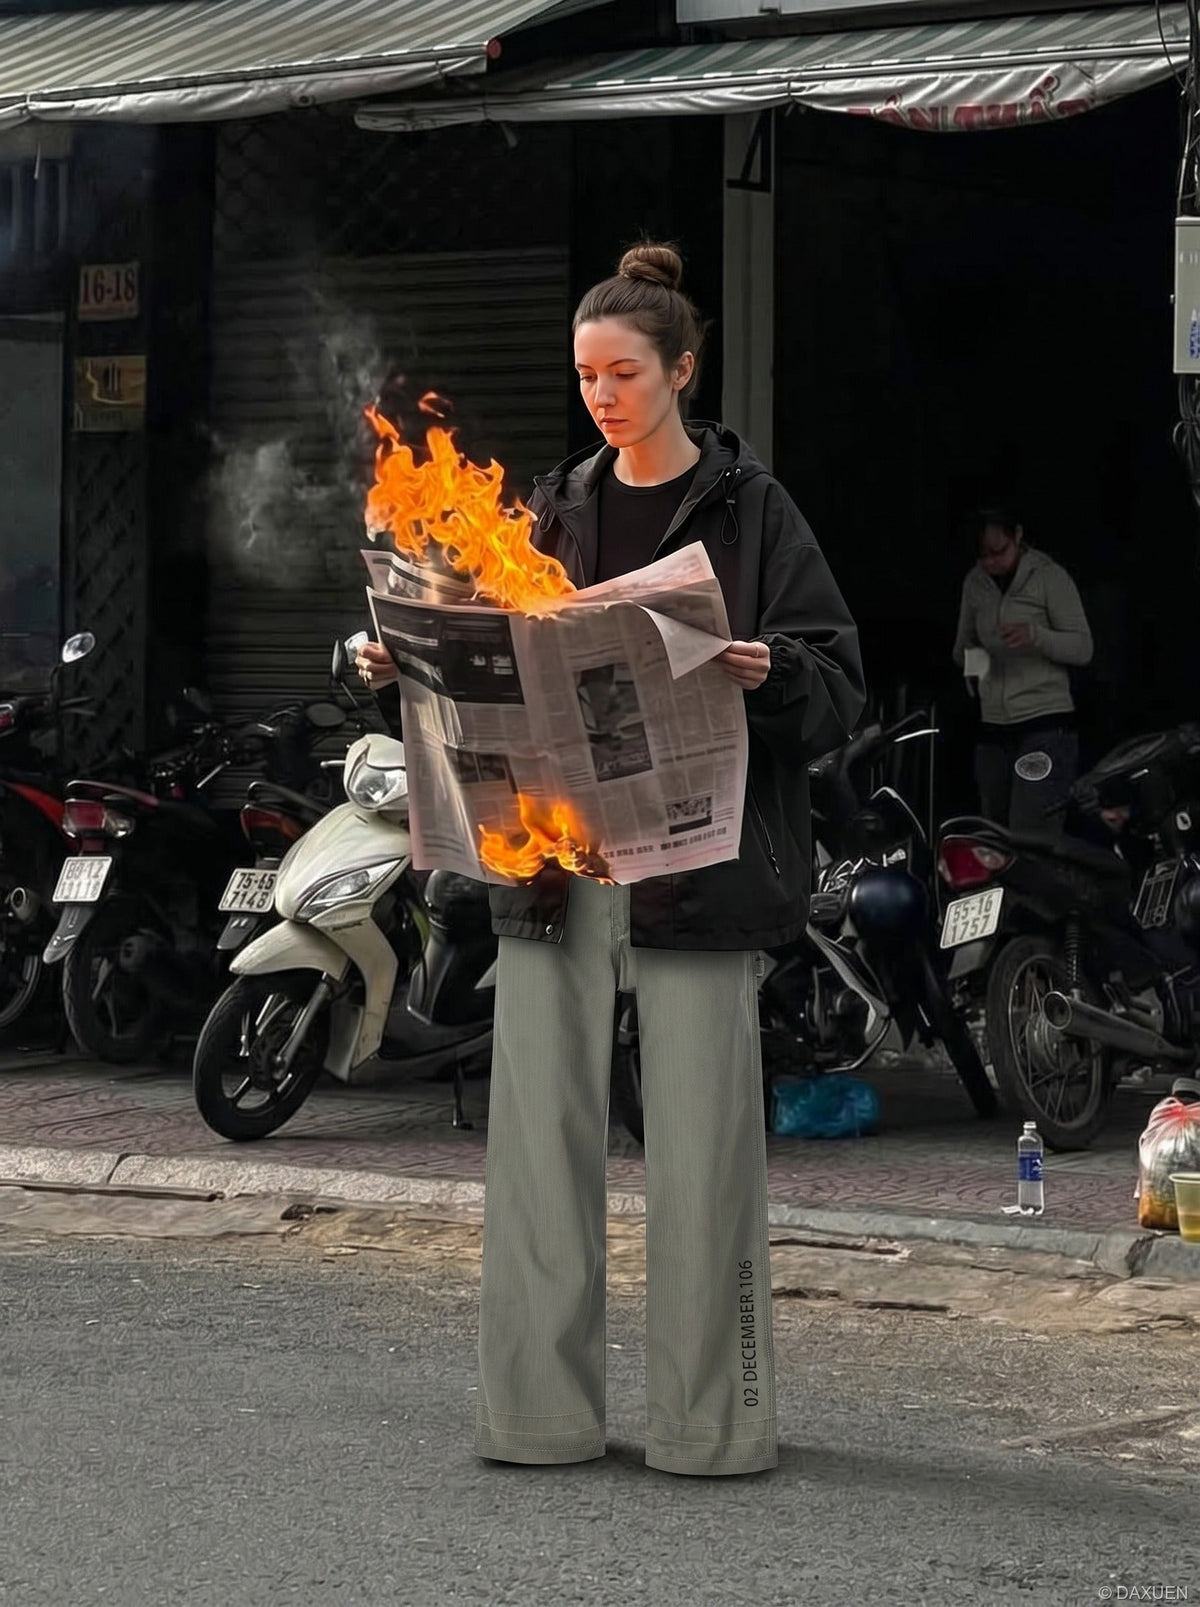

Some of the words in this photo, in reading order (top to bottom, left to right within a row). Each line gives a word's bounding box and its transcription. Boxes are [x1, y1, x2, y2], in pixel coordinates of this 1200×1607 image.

[82, 268, 136, 305] 16-18
[228, 891, 270, 909] 7148
[952, 894, 993, 923] 55-16
[951, 914, 990, 944] 1757
[738, 1259, 758, 1382] DECEMBER.106
[743, 1387, 759, 1407] 02
